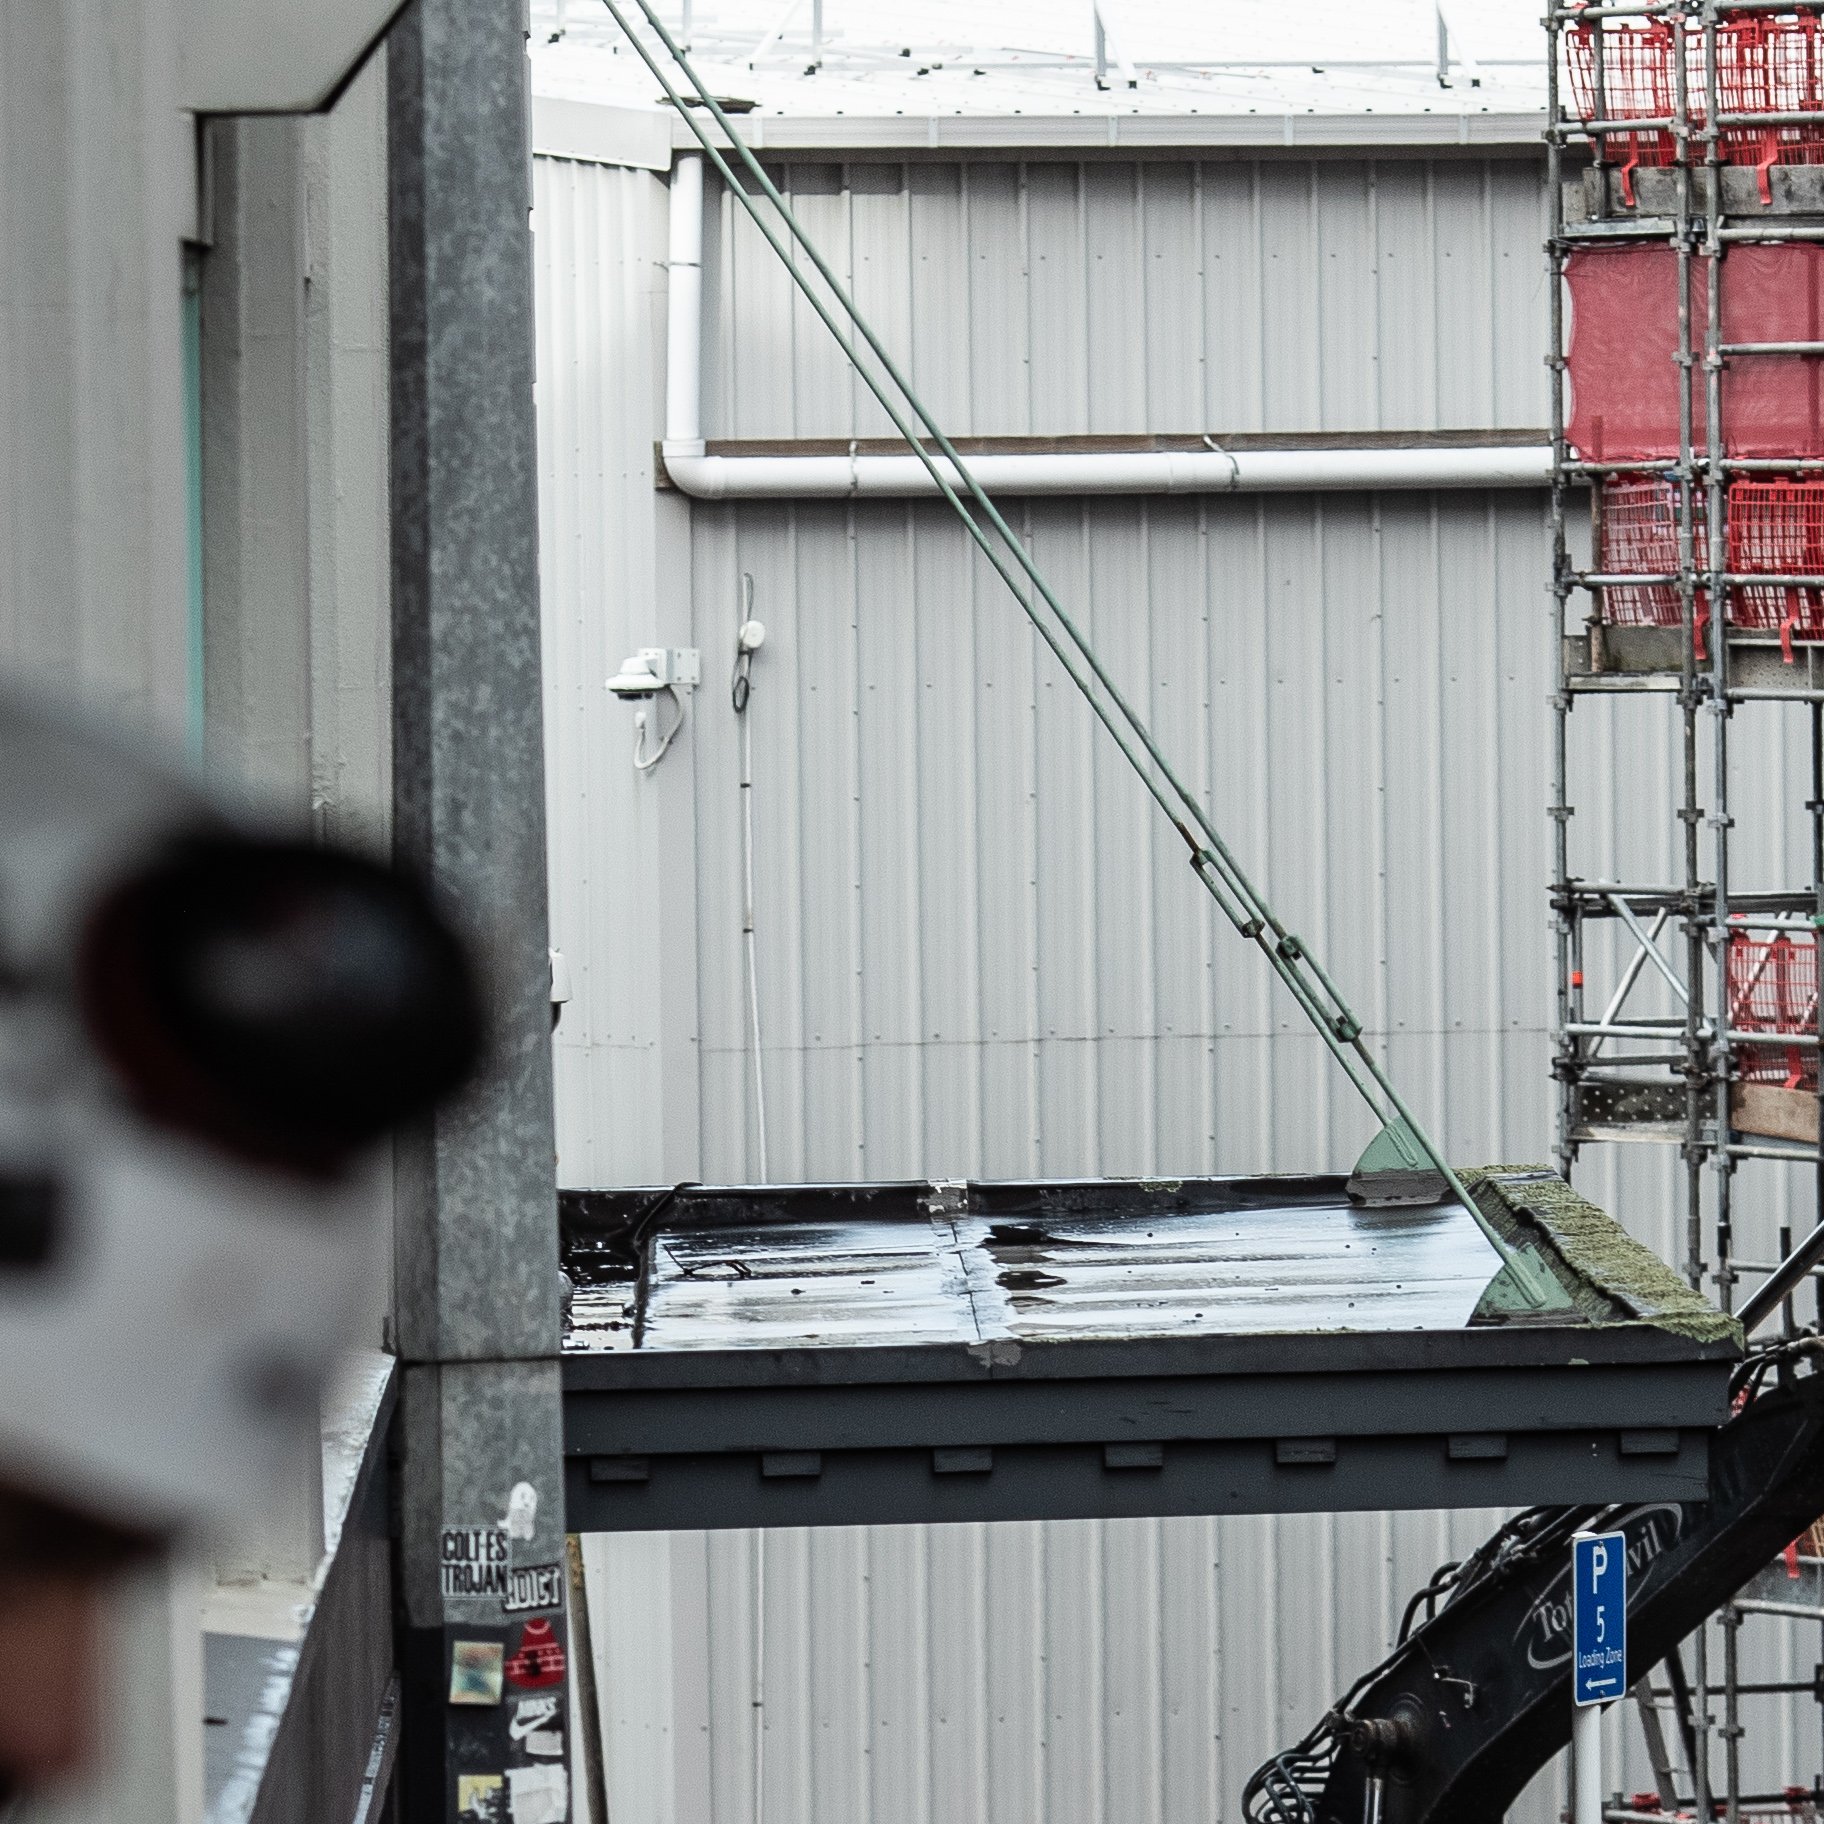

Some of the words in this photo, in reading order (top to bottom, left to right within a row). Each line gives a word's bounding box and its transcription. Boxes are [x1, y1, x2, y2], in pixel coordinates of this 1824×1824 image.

[441, 1562, 508, 1594] TROJAN
[1592, 1546, 1608, 1594] P
[1595, 1605, 1606, 1643] 5
[1578, 1649, 1605, 1669] Loading
[1605, 1646, 1623, 1664] Zone
